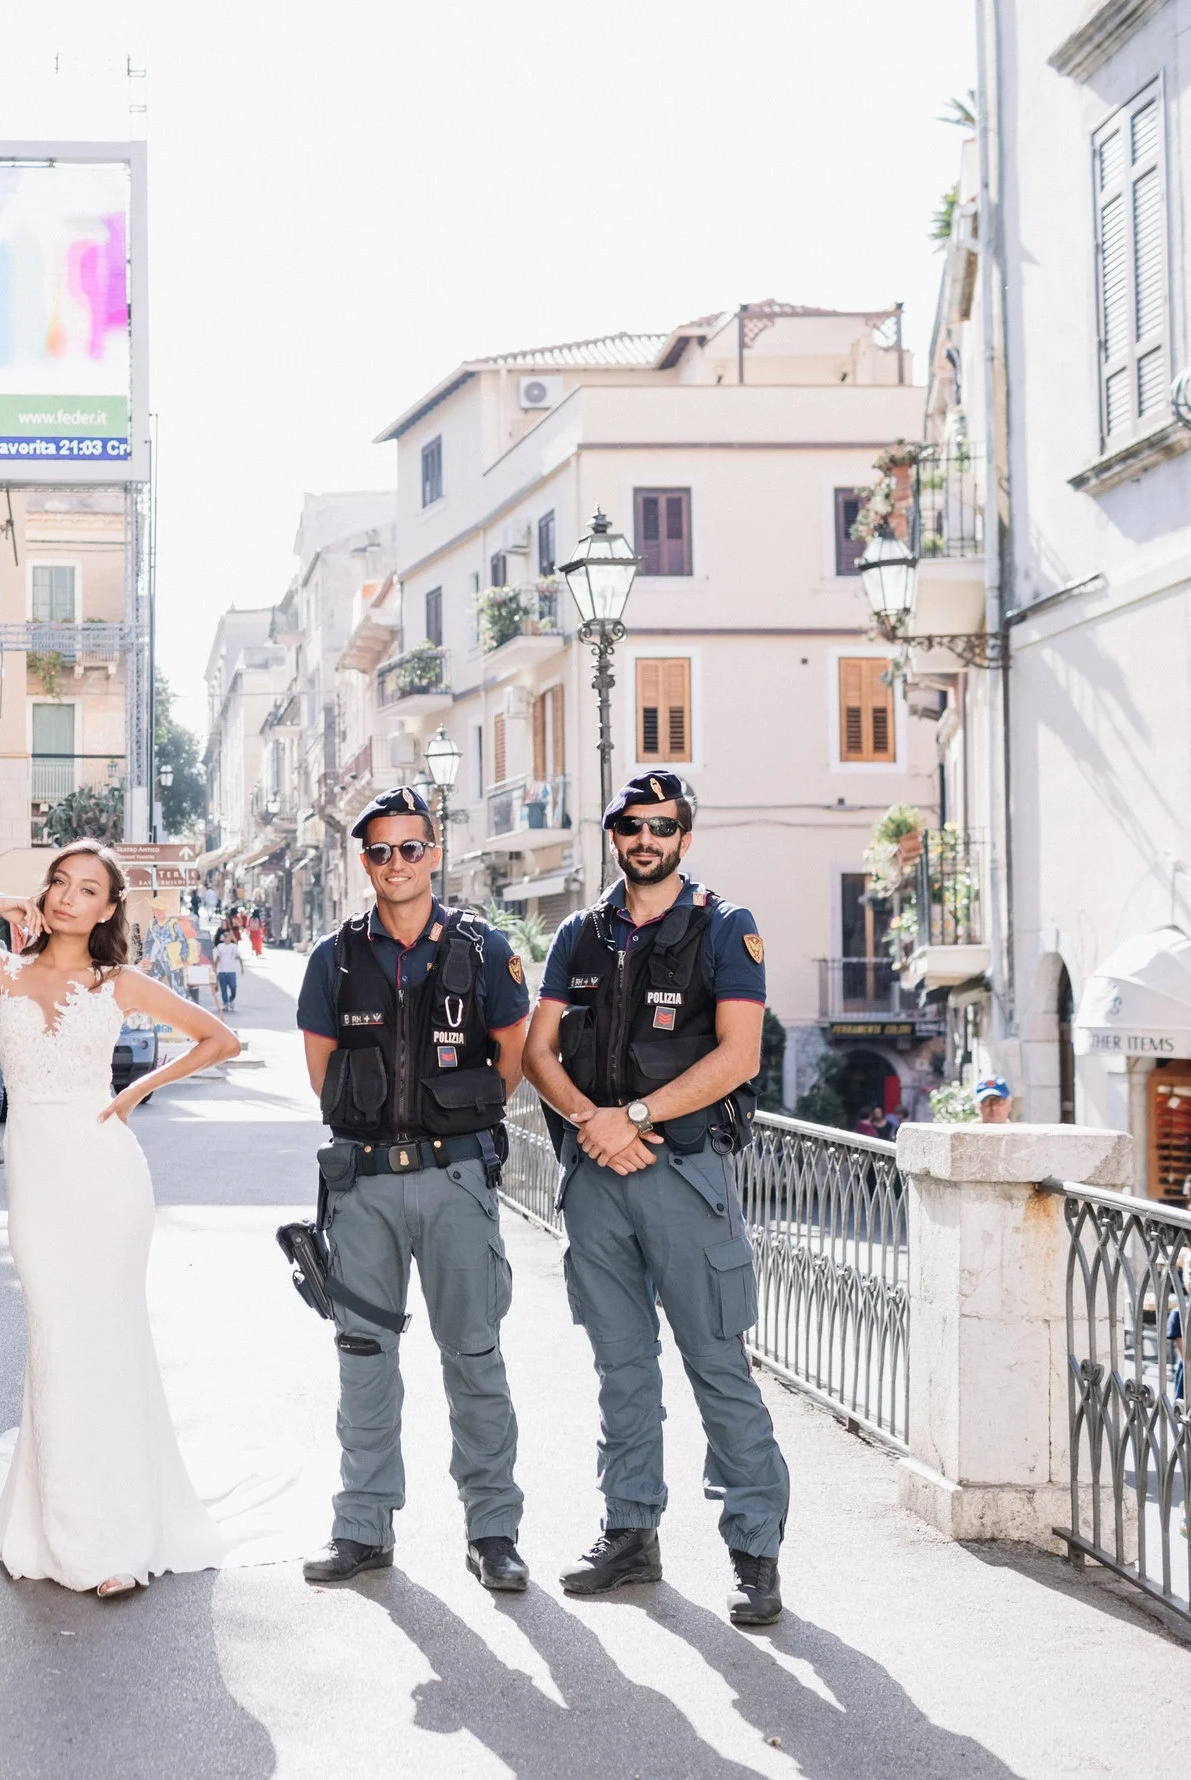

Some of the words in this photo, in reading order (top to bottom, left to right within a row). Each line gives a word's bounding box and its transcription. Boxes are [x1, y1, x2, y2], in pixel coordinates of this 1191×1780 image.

[18, 410, 107, 425] www.feder.it
[647, 991, 682, 1005] POLIZIA
[433, 1030, 464, 1044] POLIZIA
[1128, 1036, 1175, 1052] ITEMS
